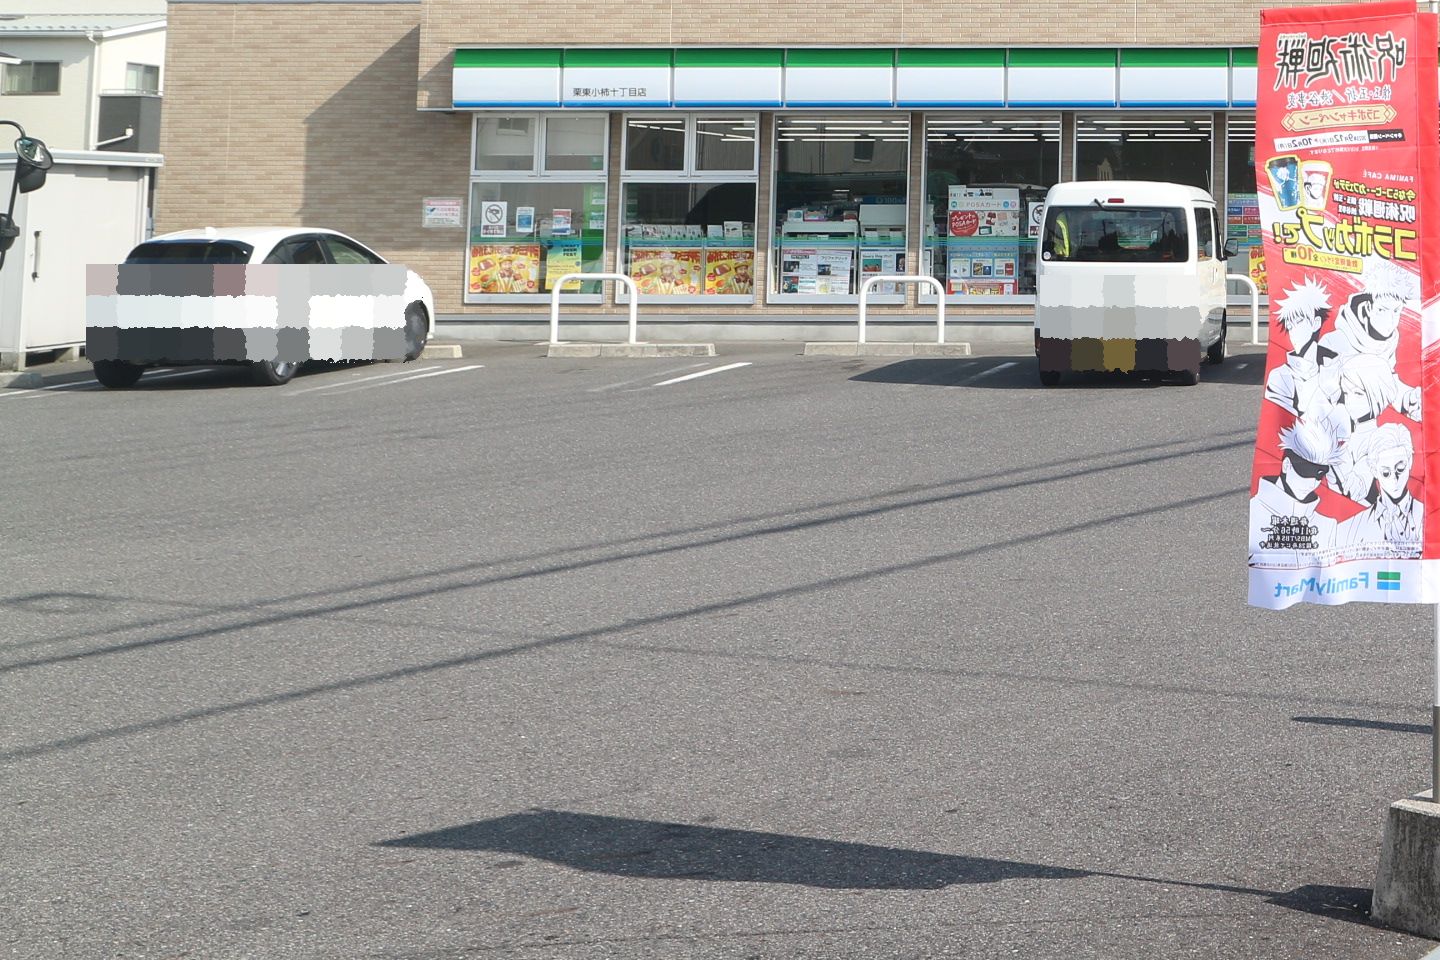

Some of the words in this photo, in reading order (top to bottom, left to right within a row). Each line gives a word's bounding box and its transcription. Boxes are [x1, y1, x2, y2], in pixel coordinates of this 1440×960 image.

[573, 87, 647, 97] 栗東小柿十丁目店
